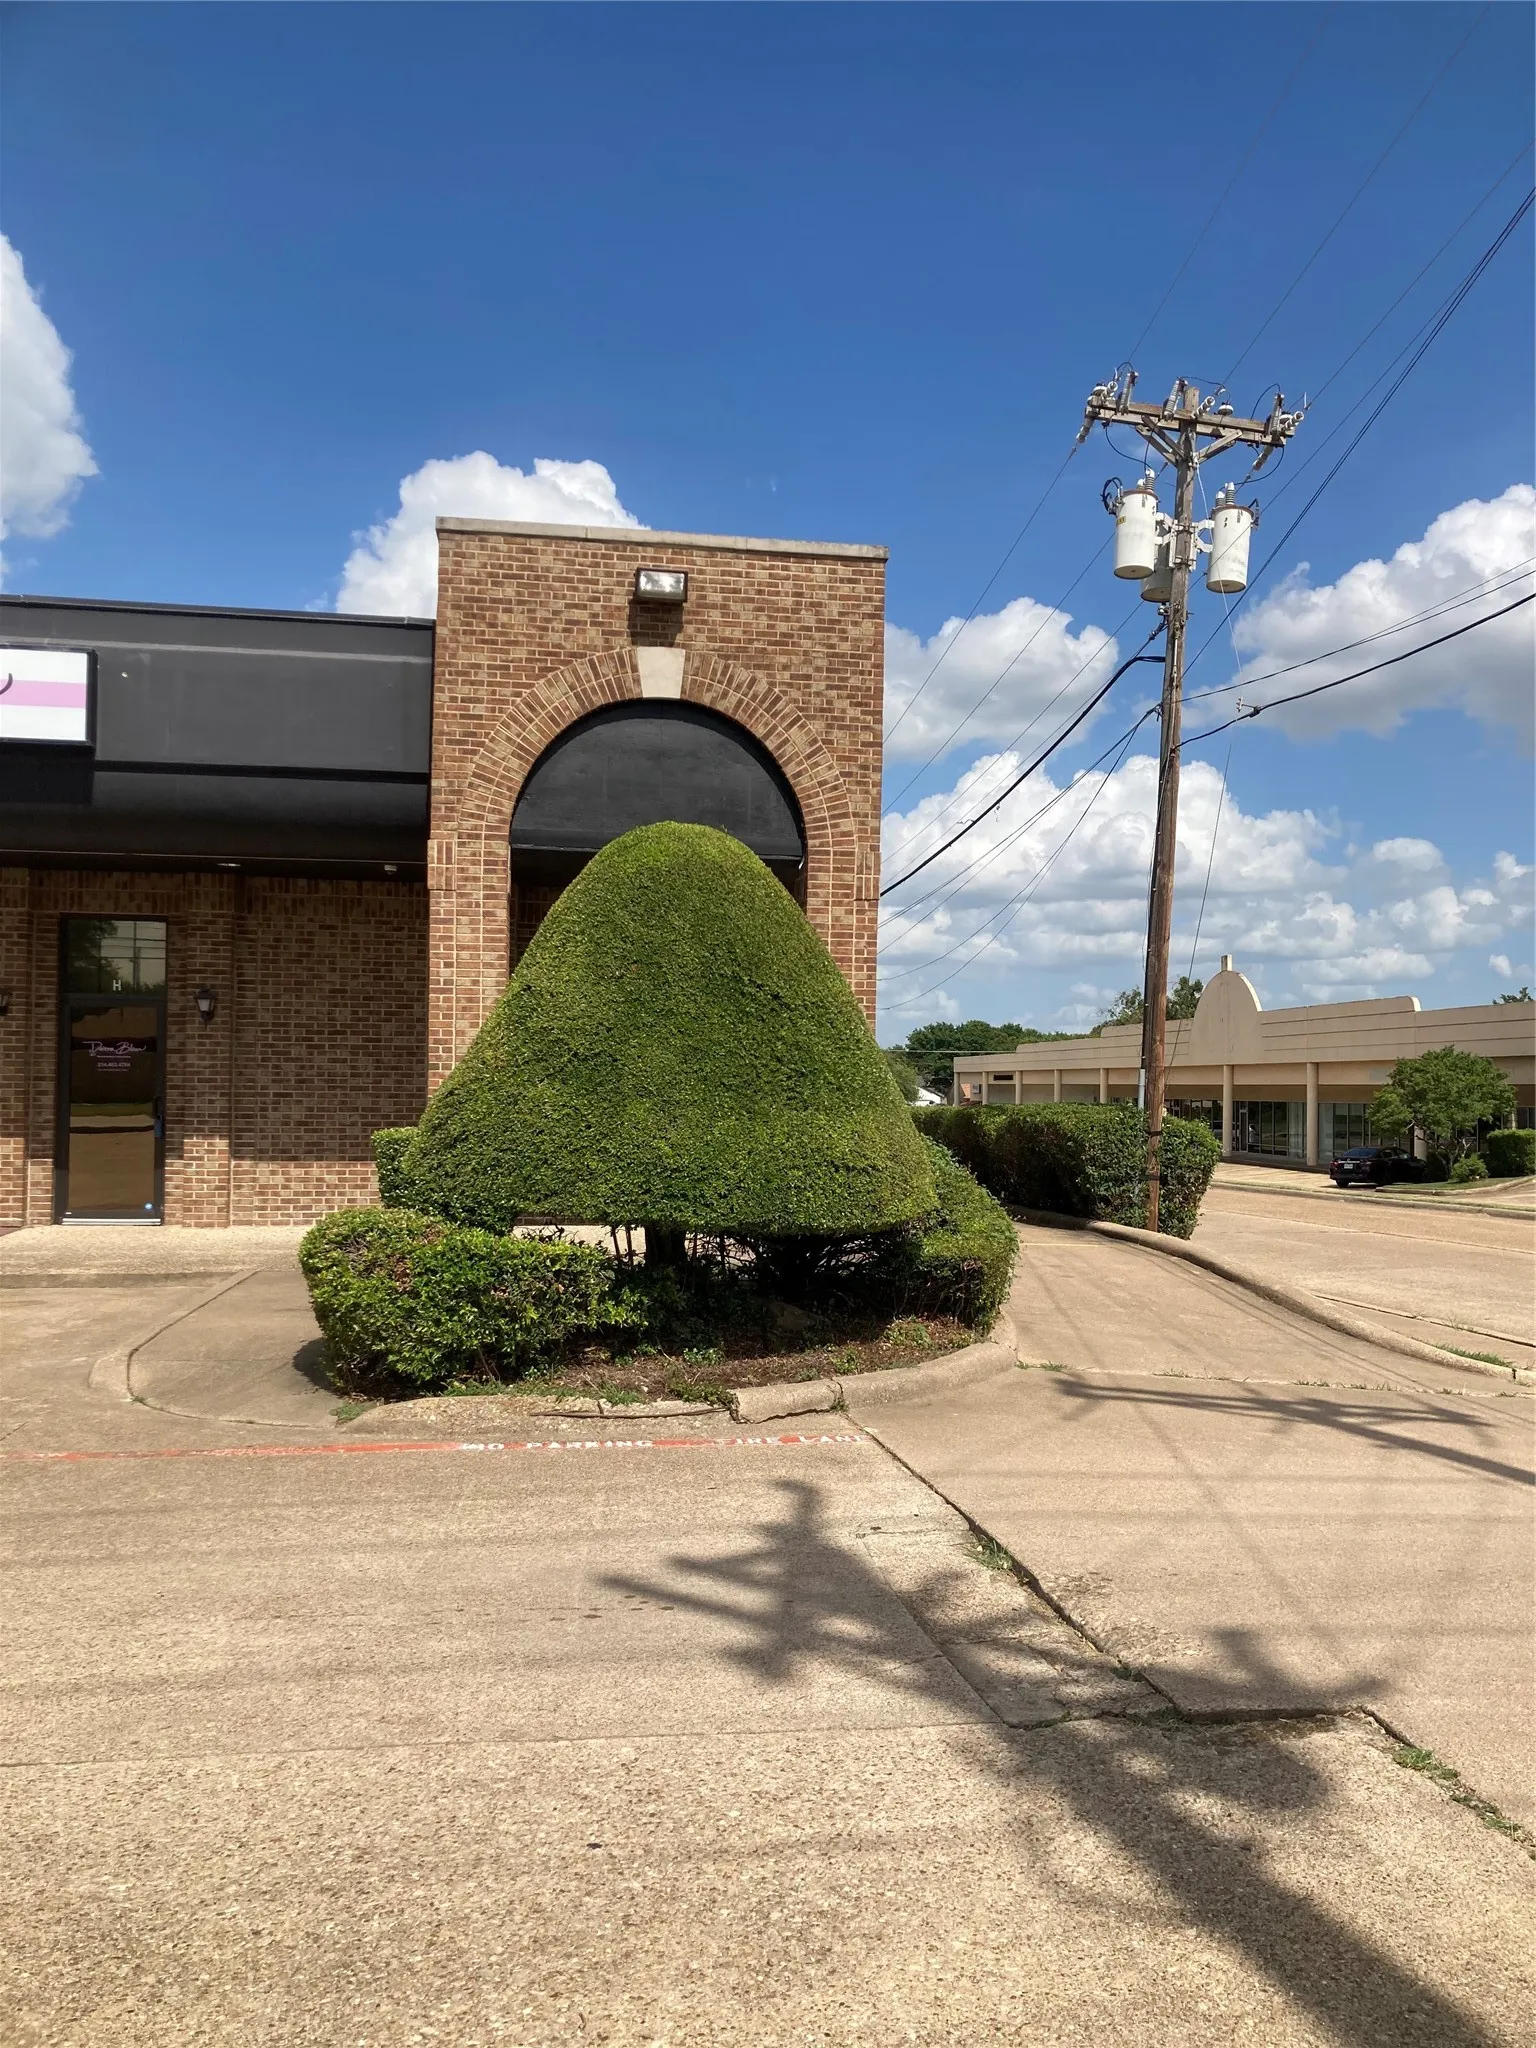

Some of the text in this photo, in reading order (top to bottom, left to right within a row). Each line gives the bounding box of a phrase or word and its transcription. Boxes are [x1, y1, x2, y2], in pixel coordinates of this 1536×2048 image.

[112, 979, 122, 991] H
[461, 1442, 505, 1450] NO
[526, 1440, 654, 1450] PARKING
